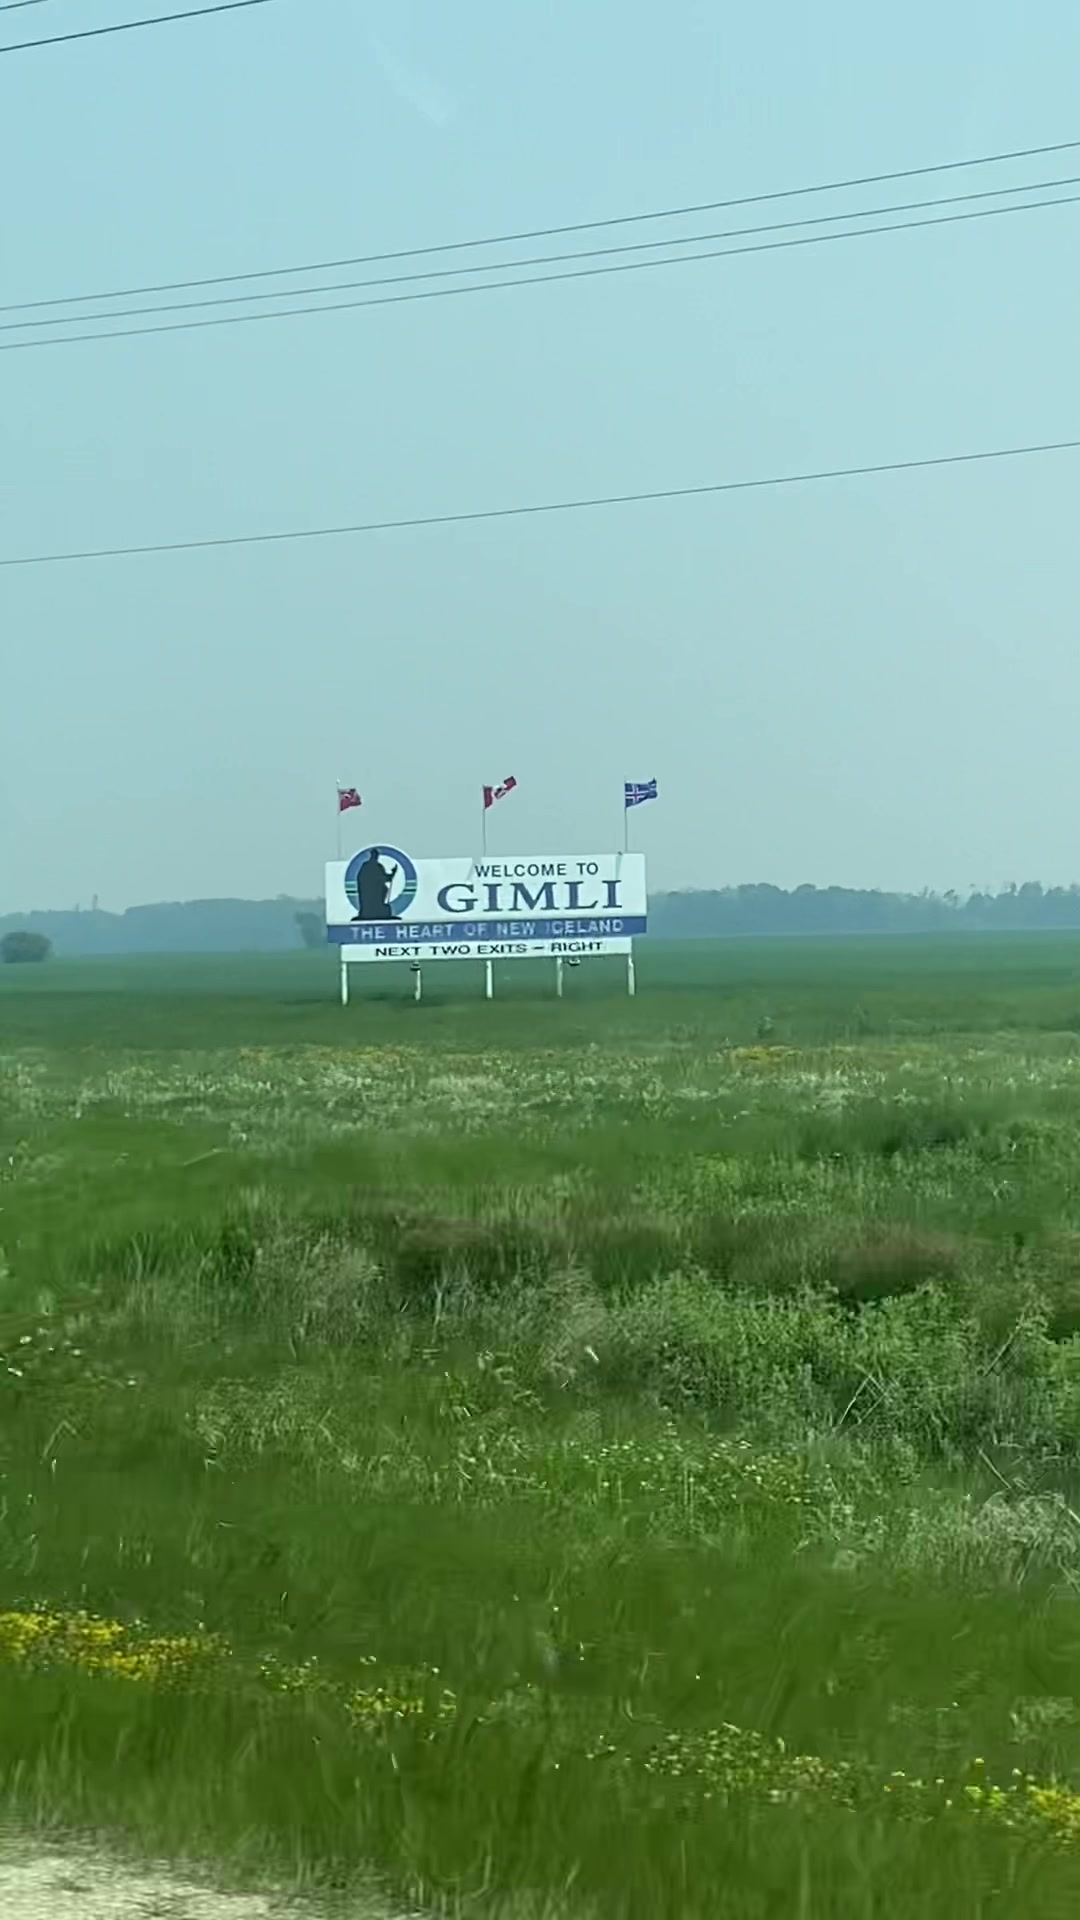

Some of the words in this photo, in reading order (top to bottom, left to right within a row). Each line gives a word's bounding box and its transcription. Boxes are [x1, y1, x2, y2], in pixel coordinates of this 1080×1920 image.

[475, 863, 567, 878] WELCOME
[576, 862, 599, 875] TO
[437, 880, 623, 913] GIMLI
[351, 927, 385, 940] THE
[396, 925, 454, 938] HEART
[463, 923, 487, 937] OF
[497, 923, 536, 935] NEW
[375, 946, 421, 957] NEXT
[429, 945, 471, 955] TWO
[477, 943, 528, 954] EXITS
[551, 942, 603, 952] RIGHT
